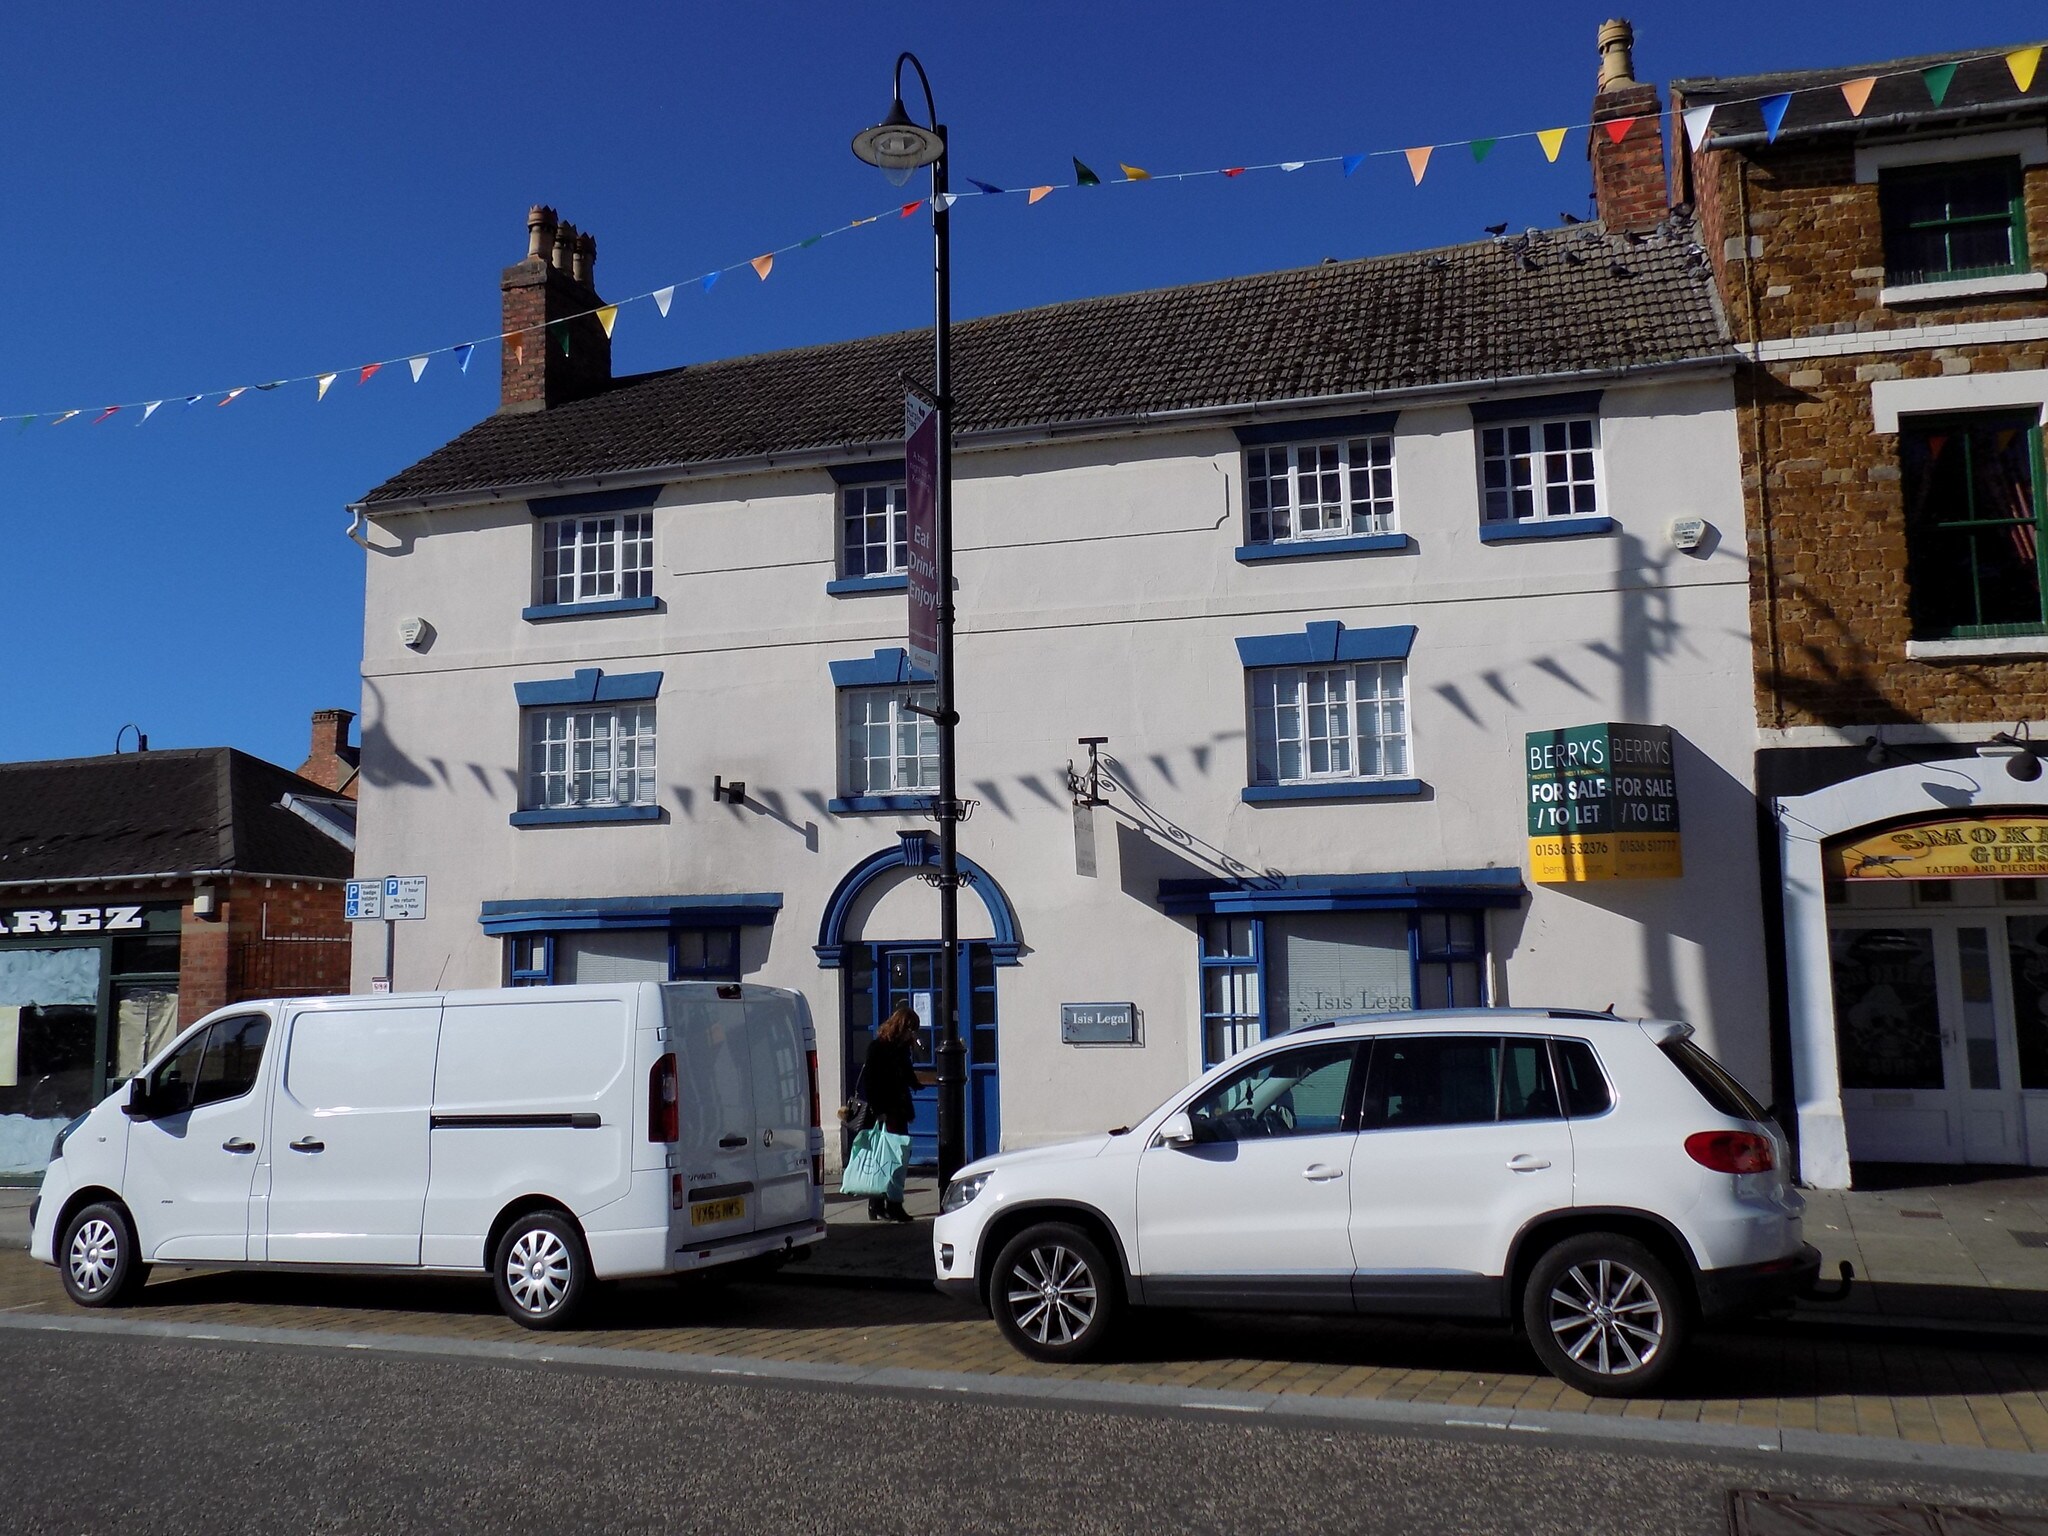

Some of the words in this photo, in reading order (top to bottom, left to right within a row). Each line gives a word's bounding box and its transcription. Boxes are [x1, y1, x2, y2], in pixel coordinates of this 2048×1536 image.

[914, 525, 930, 549] Eat
[909, 550, 935, 580] Drink
[1530, 739, 1604, 771] BERRYS
[1613, 738, 1671, 765] BERRYS
[1532, 783, 1564, 803] FOR
[1568, 778, 1606, 800] SALE
[1615, 778, 1642, 797] FOR
[1646, 779, 1674, 797] SALE
[1548, 807, 1570, 826] TO
[1575, 805, 1600, 825] LET
[1631, 804, 1649, 822] TO
[1652, 804, 1671, 822] LET
[1535, 844, 1567, 855] 01536
[1570, 842, 1608, 855] 532376
[1970, 844, 2048, 864] GUNS
[1925, 866, 1969, 874] TATTOO
[1973, 865, 1996, 873] AND
[2000, 863, 2048, 872] PIERCIN
[1315, 991, 1353, 1010] Isis
[1360, 990, 1413, 1013] Lega
[1073, 1012, 1093, 1024] Isis
[1096, 1012, 1128, 1026] Legal
